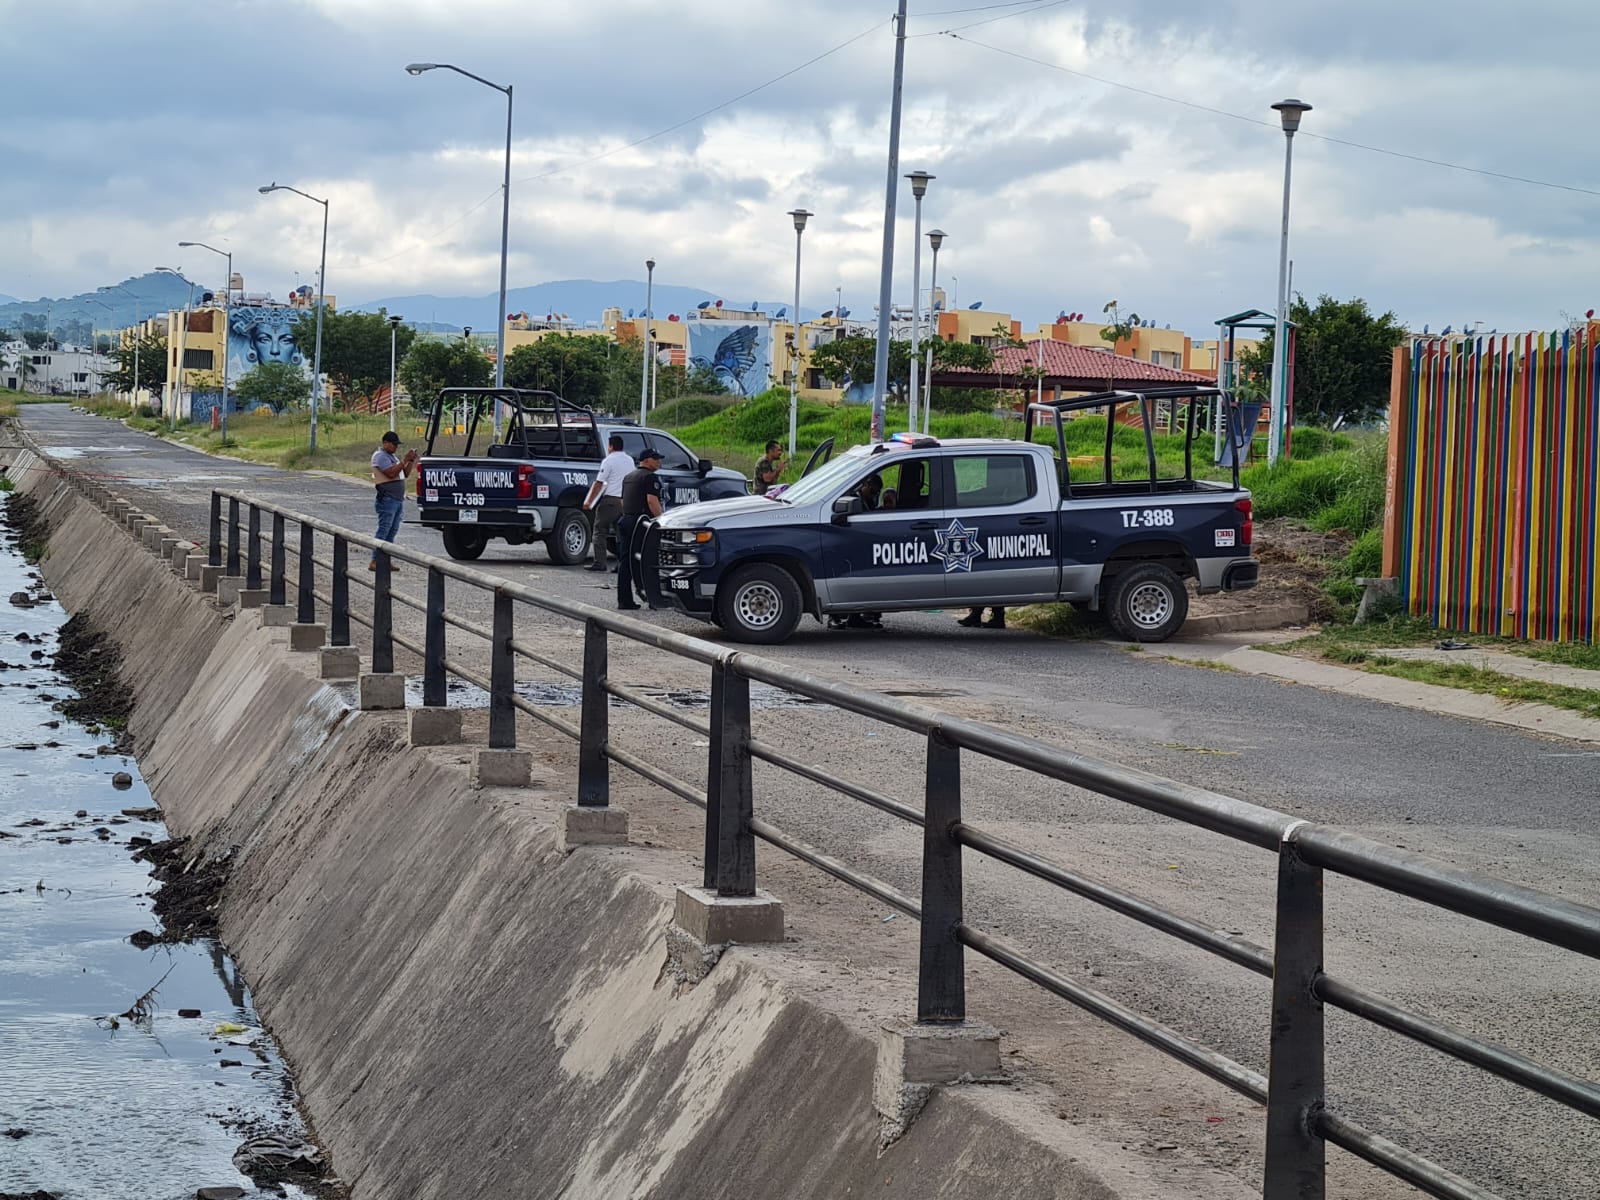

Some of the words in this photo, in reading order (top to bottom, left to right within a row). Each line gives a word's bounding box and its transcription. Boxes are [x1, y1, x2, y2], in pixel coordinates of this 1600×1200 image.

[426, 468, 457, 487] POLICÍA
[474, 471, 514, 488] MUNICIPAL
[562, 471, 589, 485] TZ-389
[452, 493, 485, 505] TZ-389
[674, 487, 701, 504] MUNICIPAL
[1120, 509, 1174, 527] TZ-388
[873, 538, 928, 565] POLICÍA
[987, 534, 1051, 559] MUNICIPAL
[671, 579, 689, 589] TZ-388
